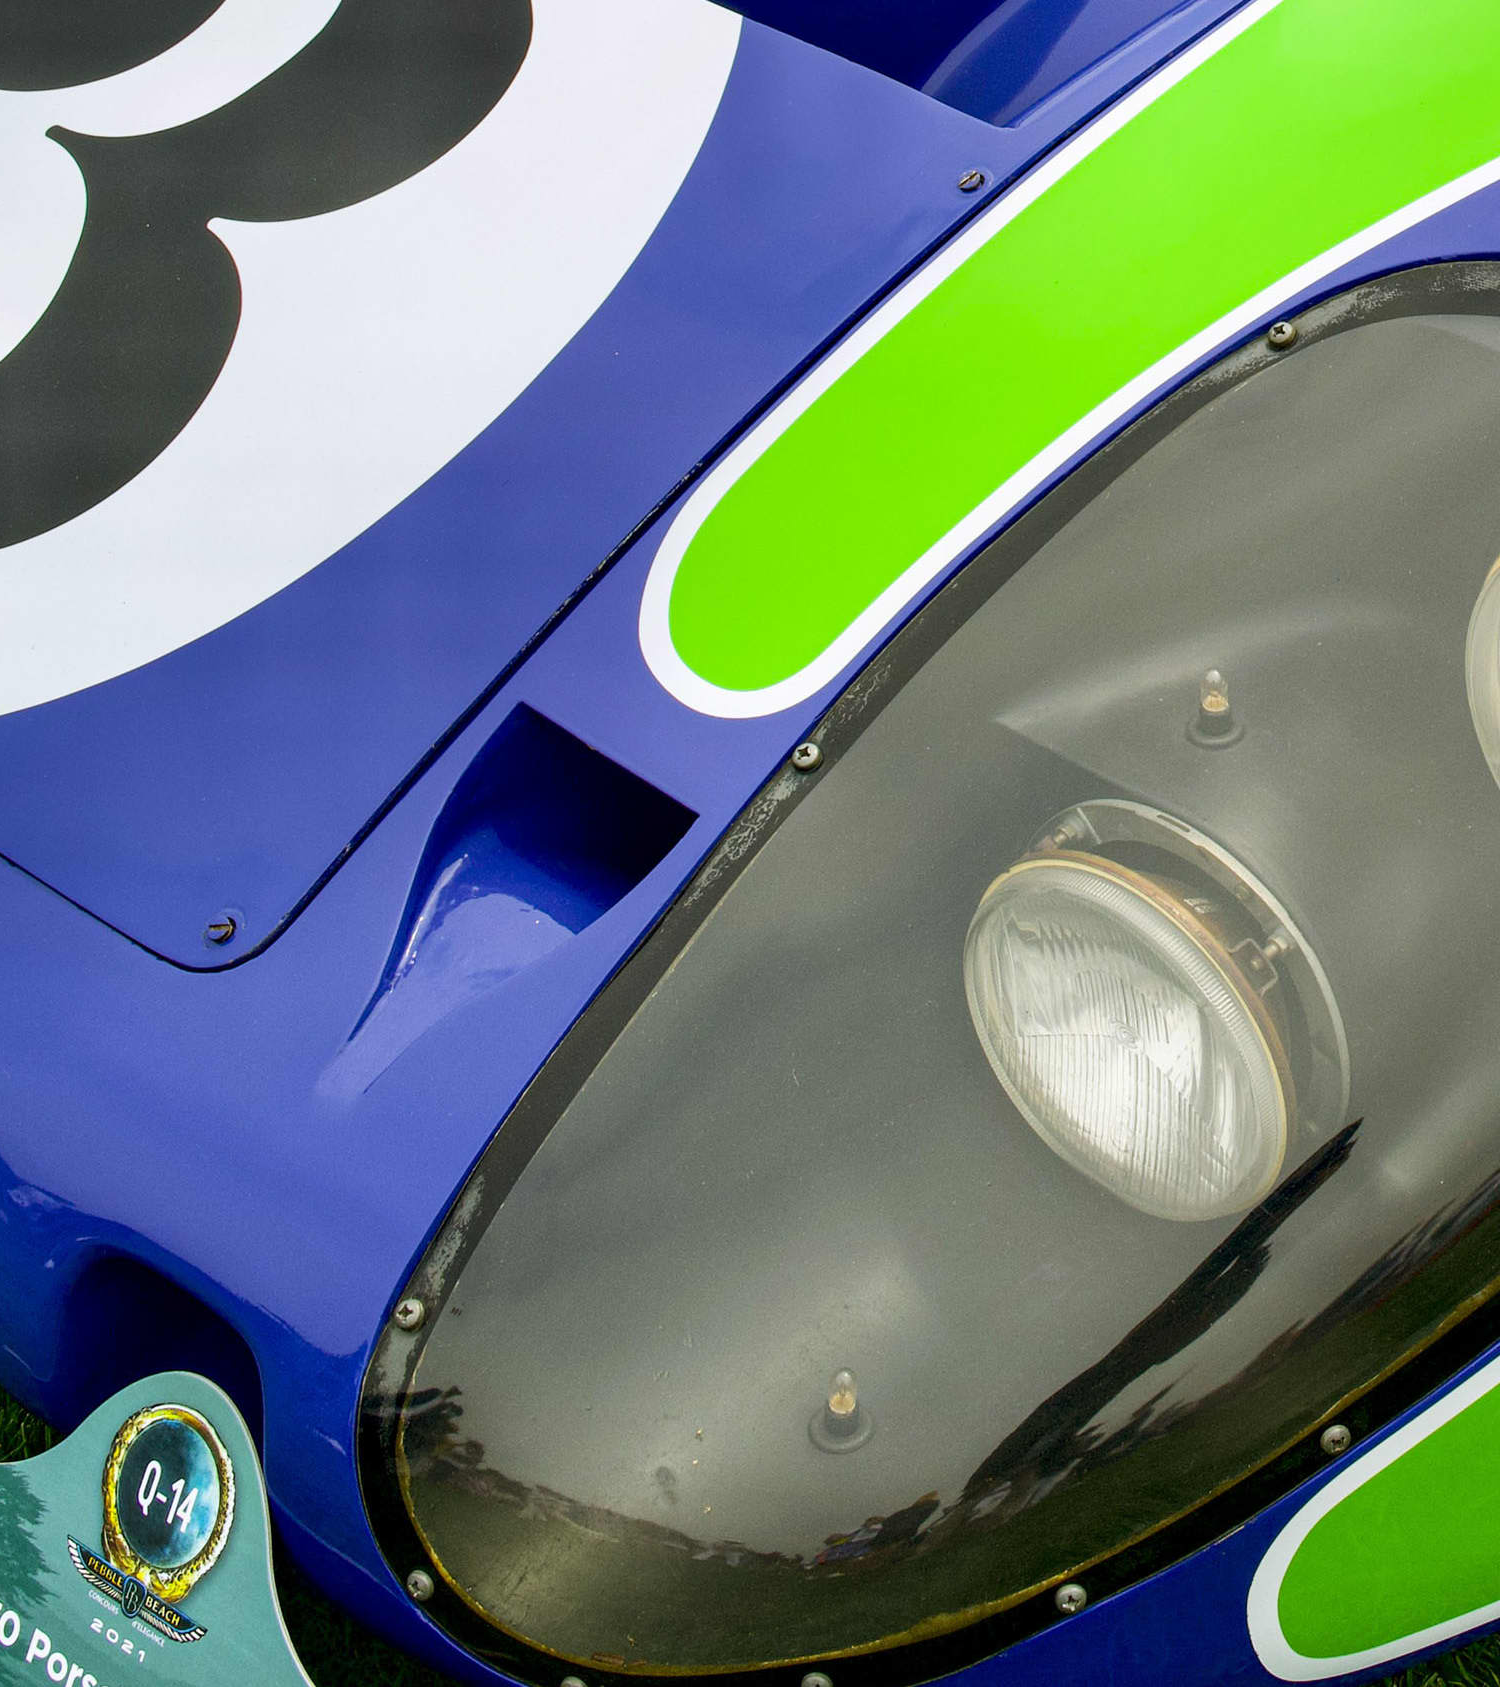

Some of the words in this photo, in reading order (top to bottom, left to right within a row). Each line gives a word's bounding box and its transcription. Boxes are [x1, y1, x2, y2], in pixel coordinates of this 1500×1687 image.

[137, 1460, 199, 1533] Q-14
[88, 1556, 124, 1587] PEBBLE
[145, 1595, 180, 1627] BEACH
[90, 1618, 146, 1663] 2021
